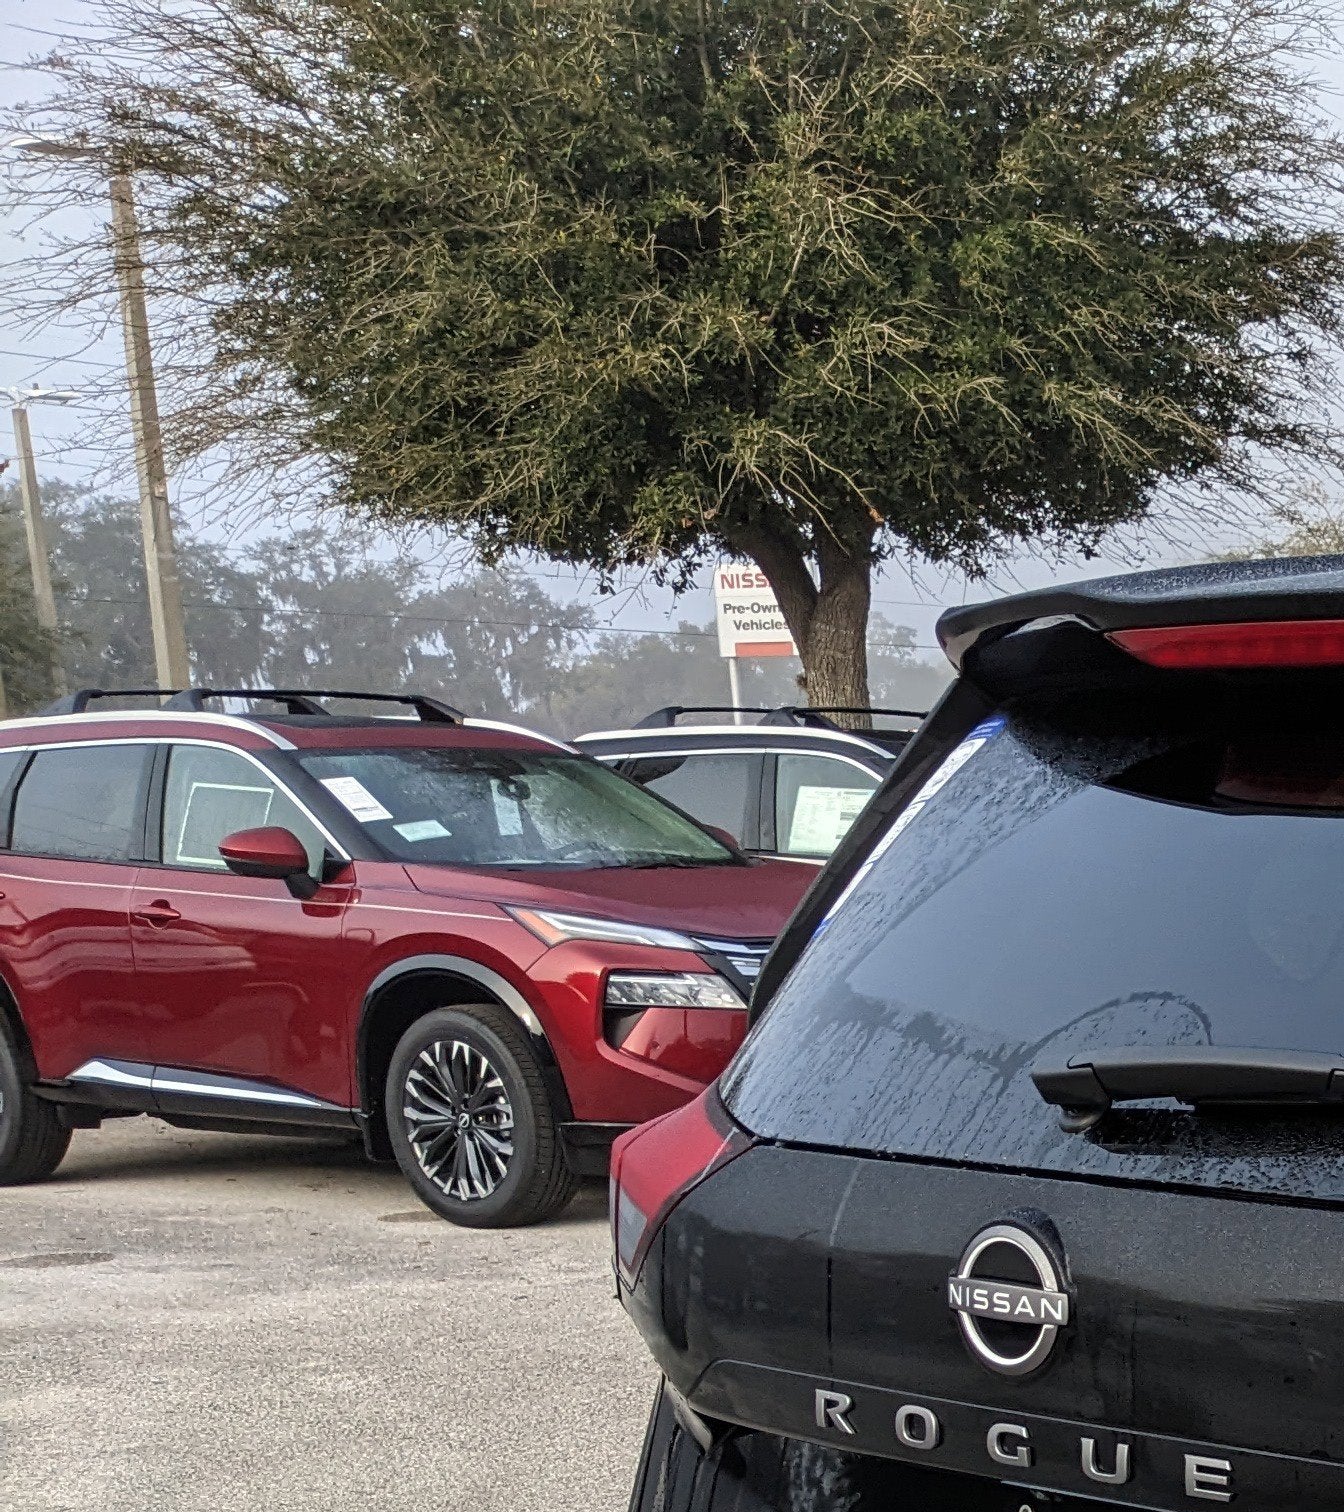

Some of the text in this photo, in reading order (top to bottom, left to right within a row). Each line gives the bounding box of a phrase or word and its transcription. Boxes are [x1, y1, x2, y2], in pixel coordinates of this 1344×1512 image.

[720, 573, 771, 590] NISS
[723, 602, 782, 615] Pre-Own
[733, 618, 789, 631] Vehicles
[948, 1282, 1064, 1322] NISSAN
[815, 1388, 1238, 1502] ROGUE
